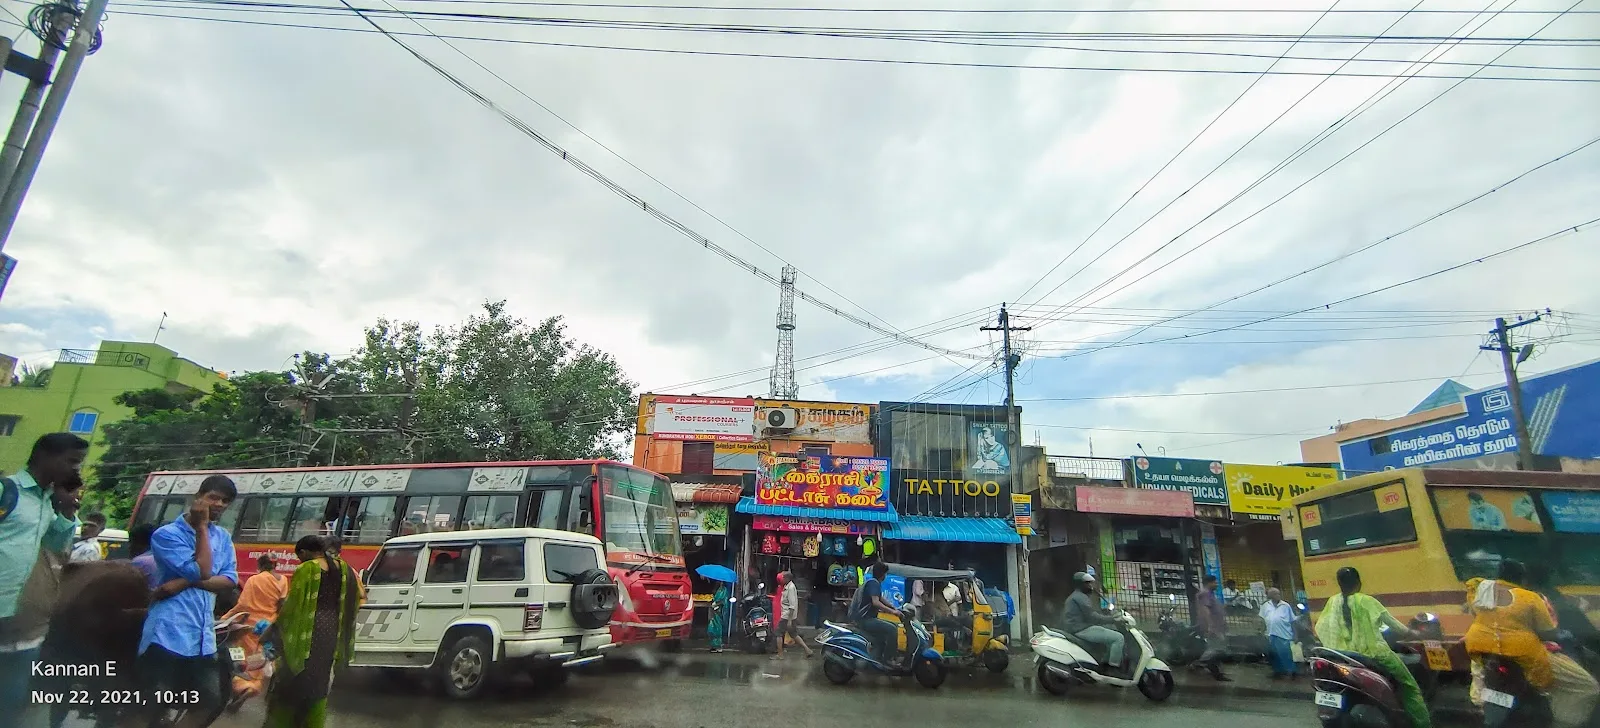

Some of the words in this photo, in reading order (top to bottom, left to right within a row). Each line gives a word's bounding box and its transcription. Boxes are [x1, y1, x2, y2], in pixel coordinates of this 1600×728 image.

[674, 415, 738, 423] PROFESSIONAL
[1391, 431, 1455, 453] சிகரத்தை
[1456, 417, 1511, 439] தொடும்
[1404, 442, 1481, 466] கம்பிகளின்
[1484, 434, 1517, 455] தரம்
[786, 471, 861, 488] கைராசி
[1144, 472, 1170, 482] உதயா
[1171, 474, 1219, 484] மெடிக்கல்ஸ்
[904, 479, 1000, 496] TATTOO
[1243, 482, 1284, 501] Daily
[760, 487, 831, 505] பட்டாசு
[836, 492, 885, 507] கடை
